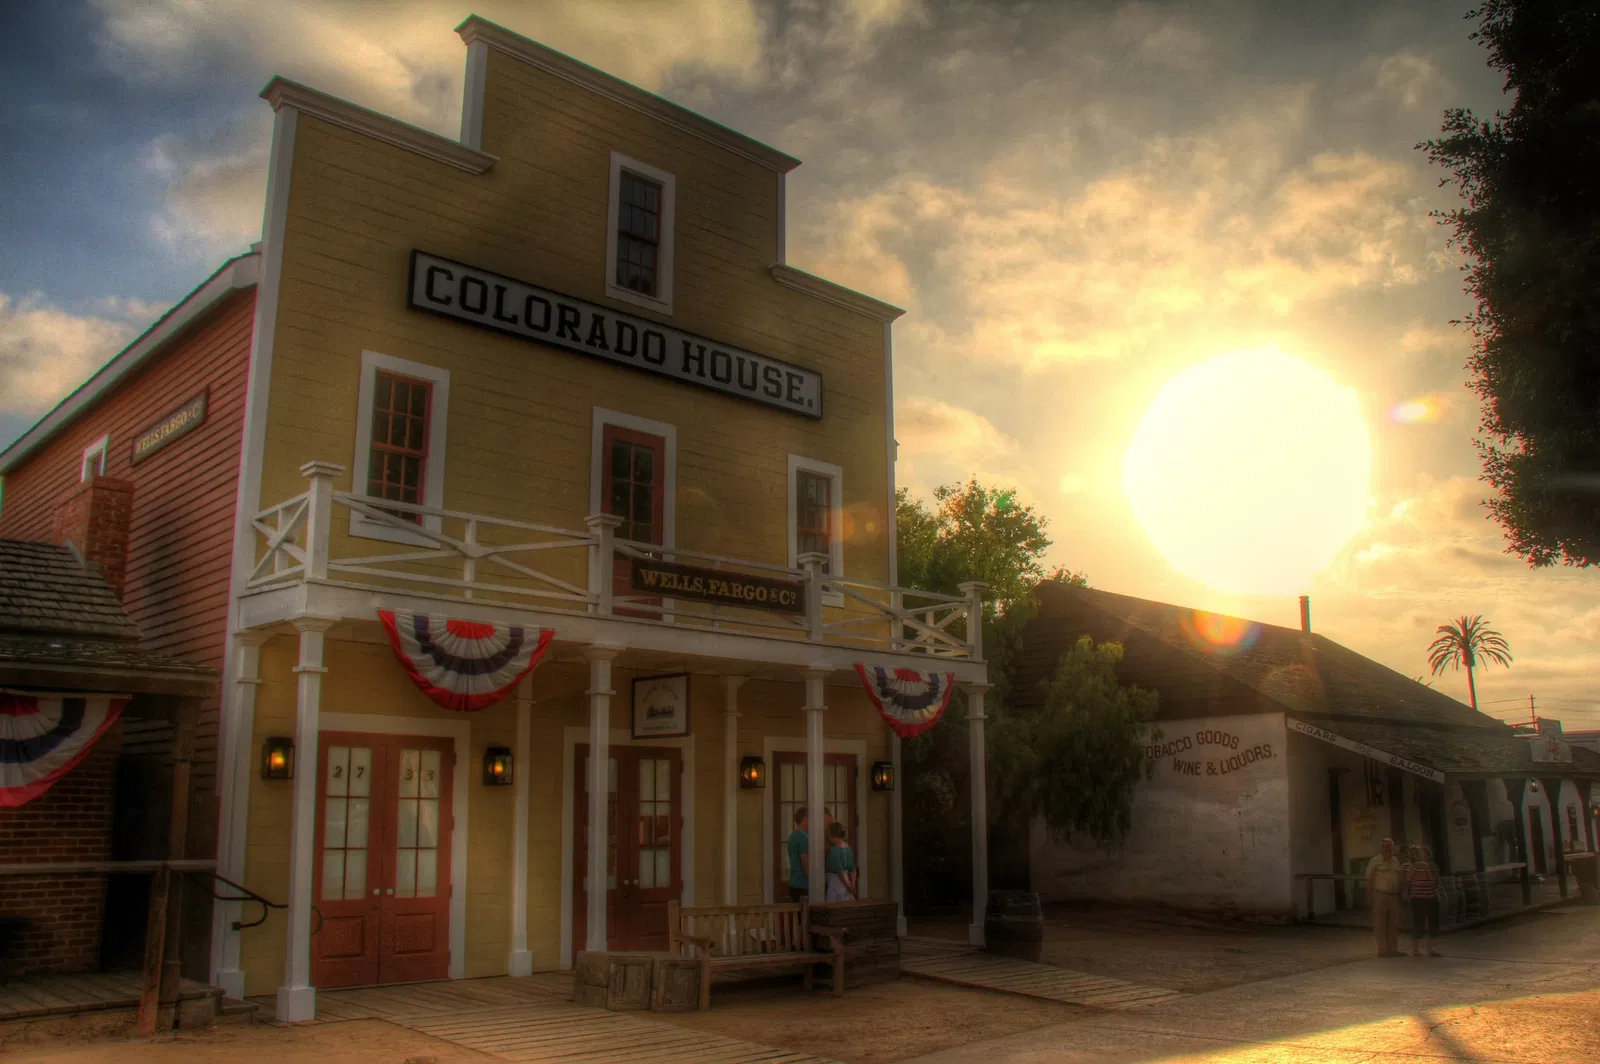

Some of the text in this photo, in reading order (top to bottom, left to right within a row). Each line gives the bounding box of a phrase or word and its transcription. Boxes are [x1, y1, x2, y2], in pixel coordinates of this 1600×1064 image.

[424, 264, 815, 409] COLORADO HOUSE.
[708, 579, 767, 602] FARGO
[1143, 730, 1241, 760] OBACCO GOODS
[1295, 721, 1338, 743] CIGARS
[1172, 744, 1279, 777] WINE & LIQUORS.
[1389, 756, 1435, 779] SALOON
